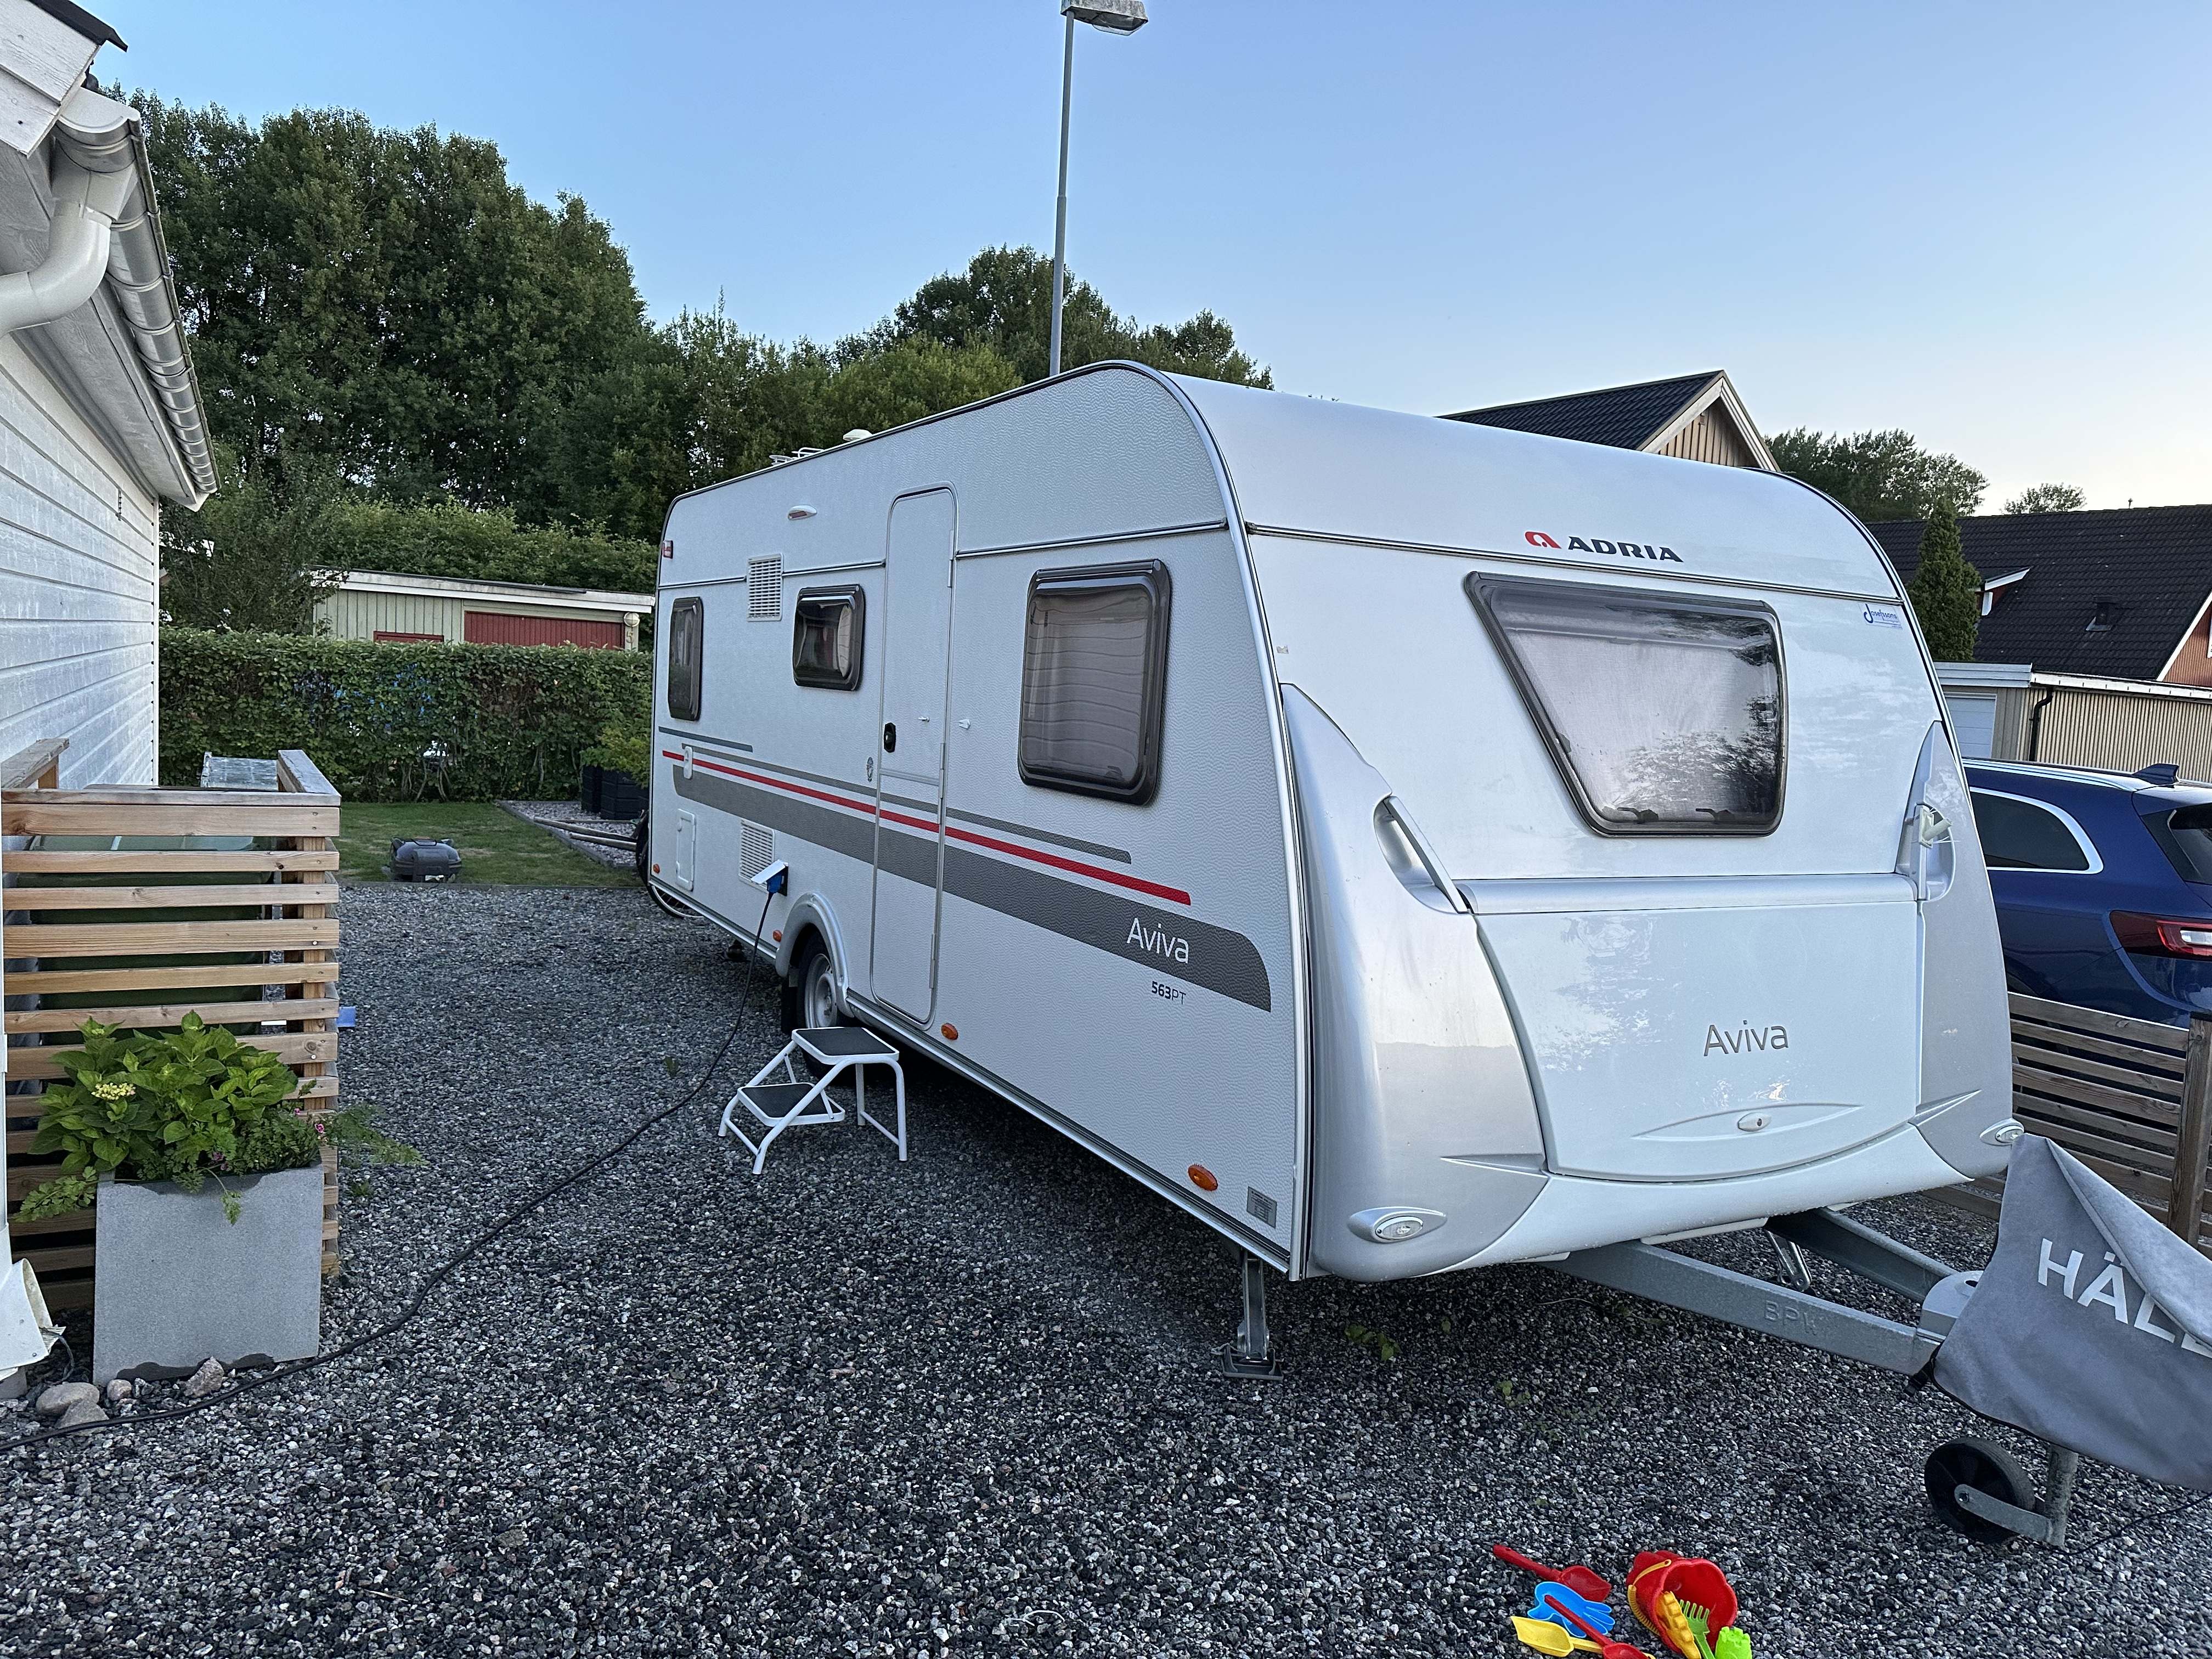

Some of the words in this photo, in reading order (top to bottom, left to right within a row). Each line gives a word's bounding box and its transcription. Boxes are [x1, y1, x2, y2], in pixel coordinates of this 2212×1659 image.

[1568, 535, 1684, 563] ADRIA
[626, 631, 634, 644] 5
[1126, 917, 1189, 963] Aviva
[1152, 980, 1186, 1005] 563PT
[1703, 1020, 1788, 1057] Aviva
[2038, 1238, 2211, 1359] HÄL
